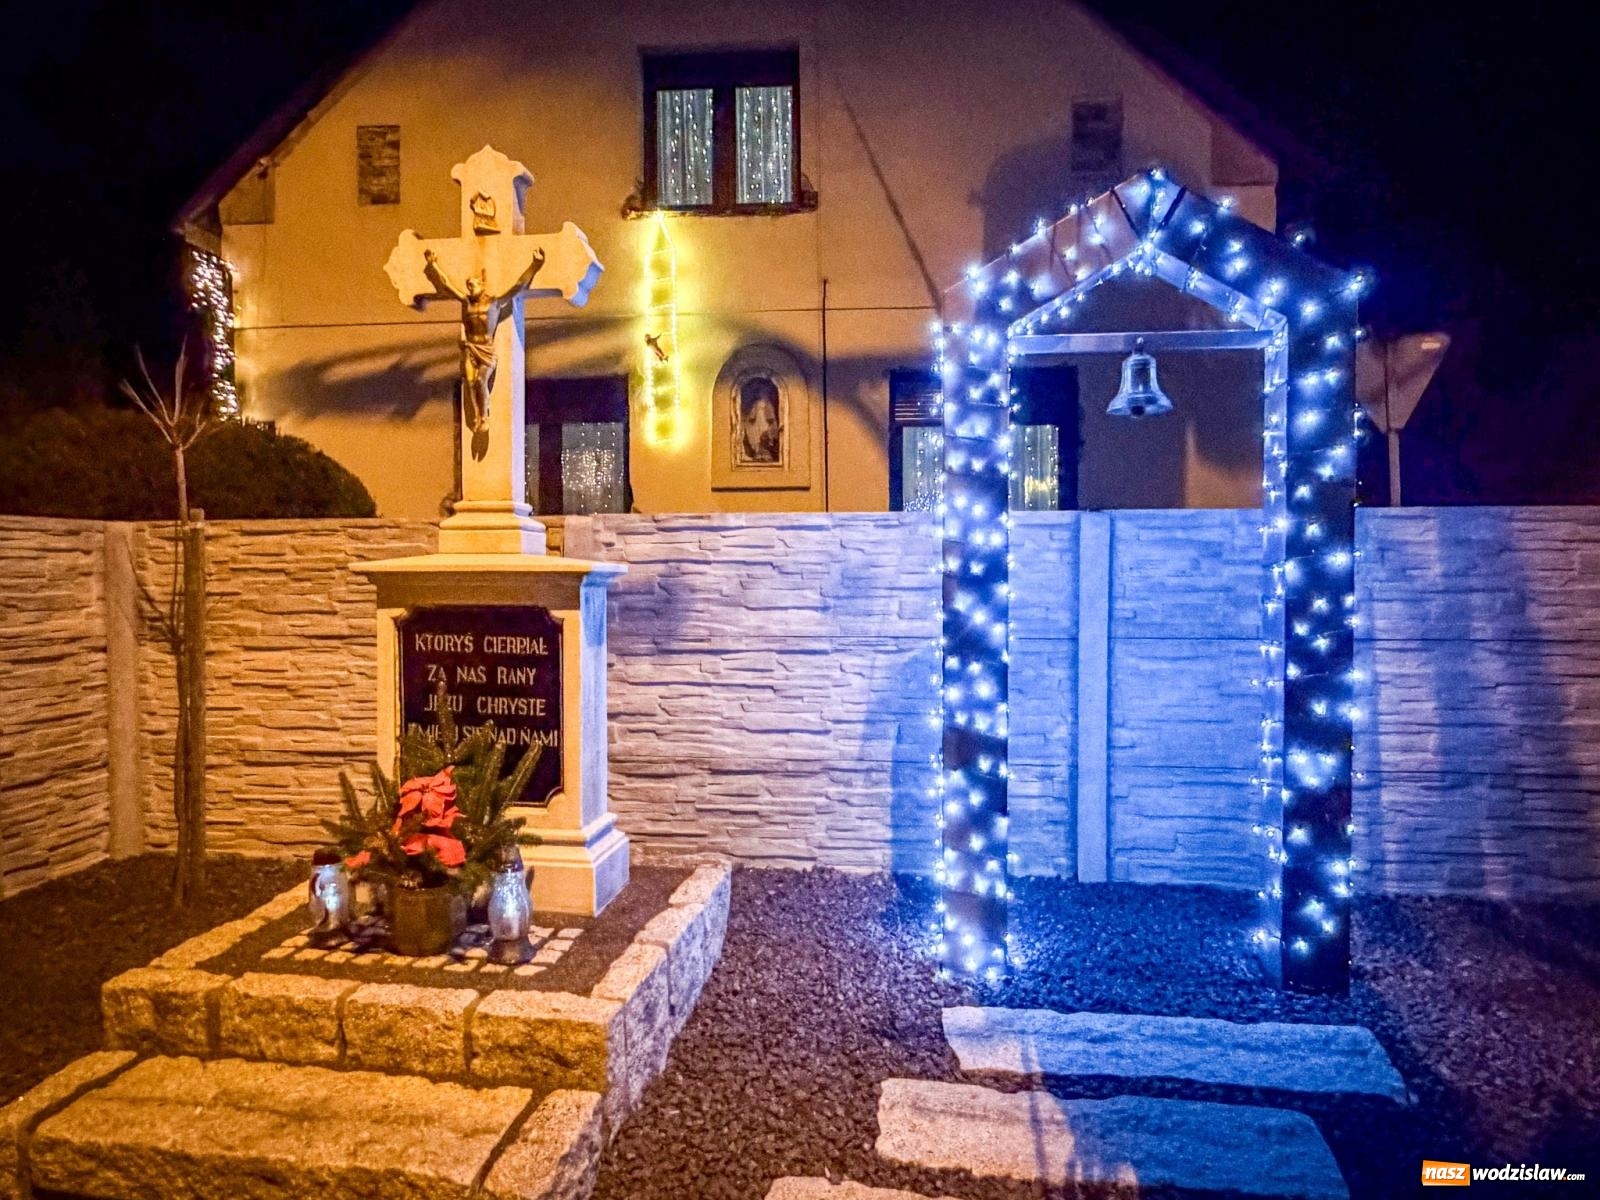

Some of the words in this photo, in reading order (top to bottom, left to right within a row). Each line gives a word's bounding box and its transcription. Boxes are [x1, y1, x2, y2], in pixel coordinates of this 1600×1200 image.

[483, 635, 549, 656] CIERPIAŁ
[427, 663, 447, 682] ZA
[456, 664, 487, 685] NAS
[497, 665, 537, 686] RANY
[424, 694, 463, 713] JZU
[476, 695, 547, 717] CHRYSTE
